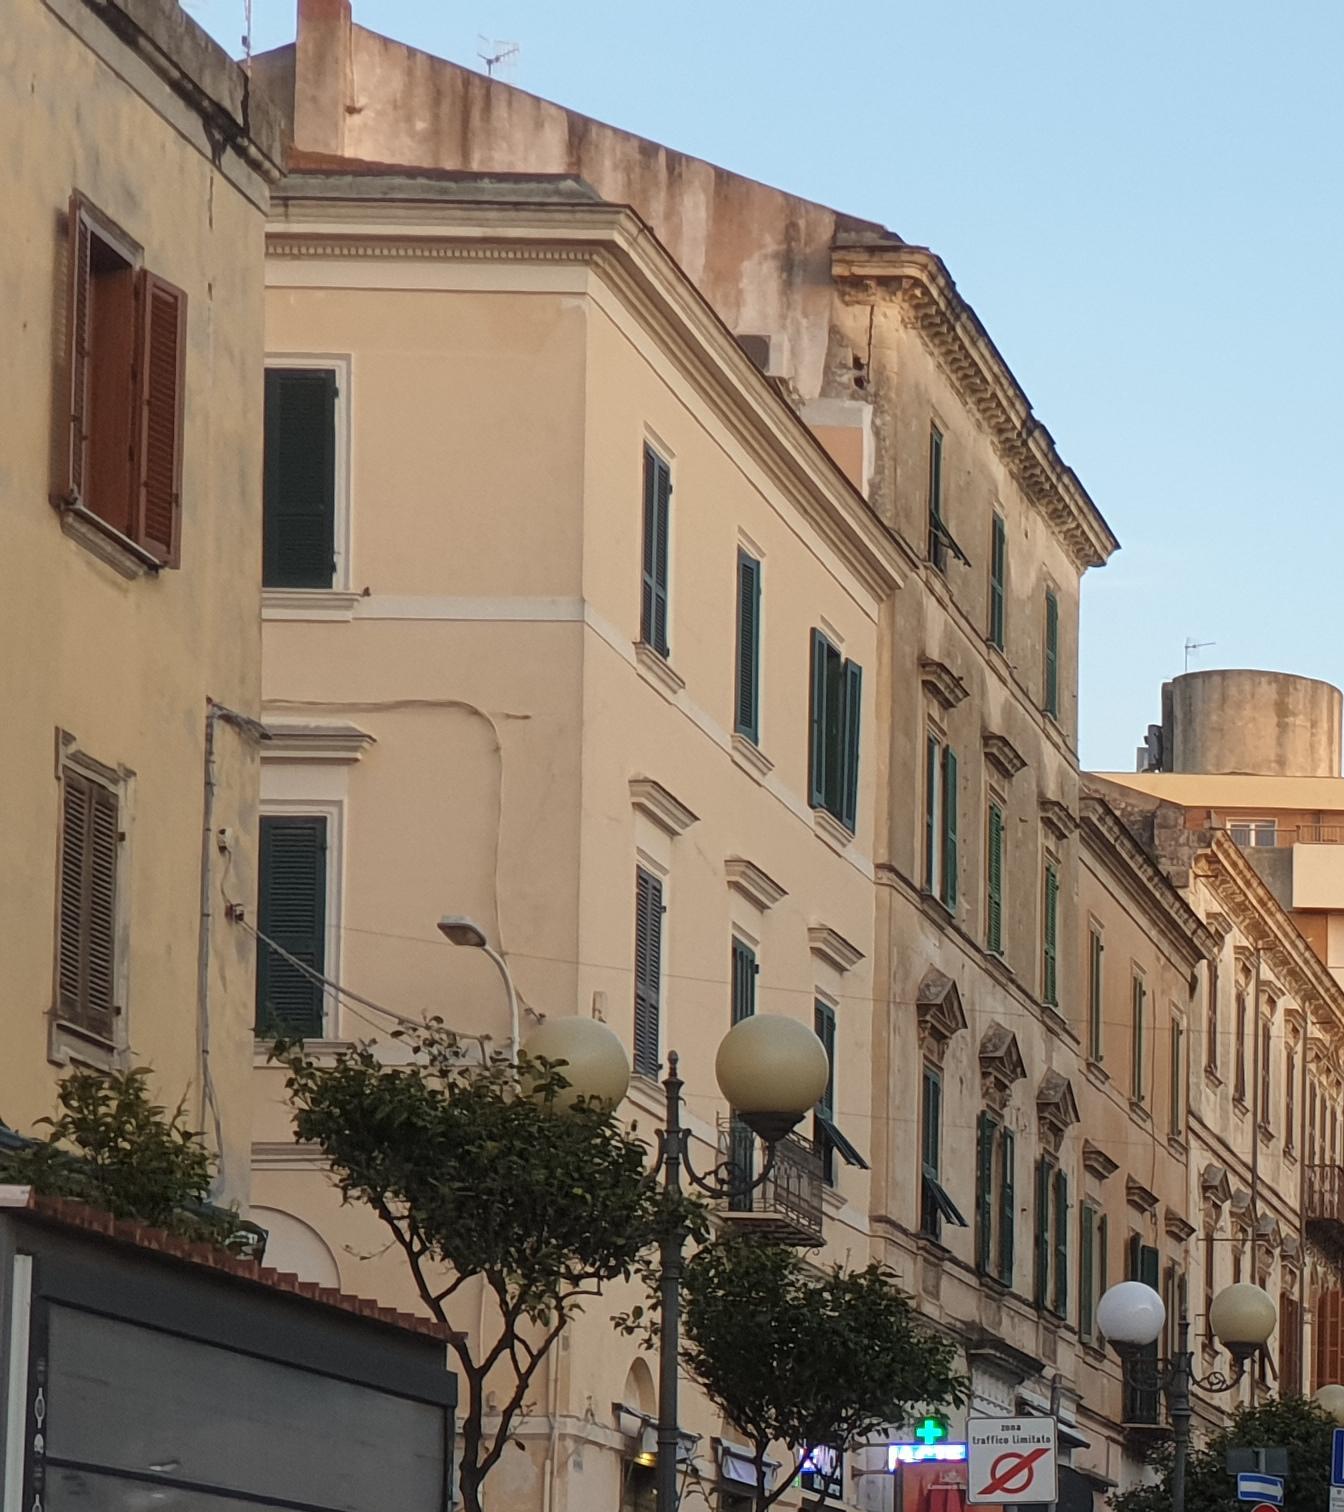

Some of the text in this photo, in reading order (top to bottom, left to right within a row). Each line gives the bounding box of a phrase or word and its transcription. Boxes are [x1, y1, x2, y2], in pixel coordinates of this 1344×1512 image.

[1001, 1424, 1022, 1432] zona
[972, 1433, 1052, 1445] traffico limitato
